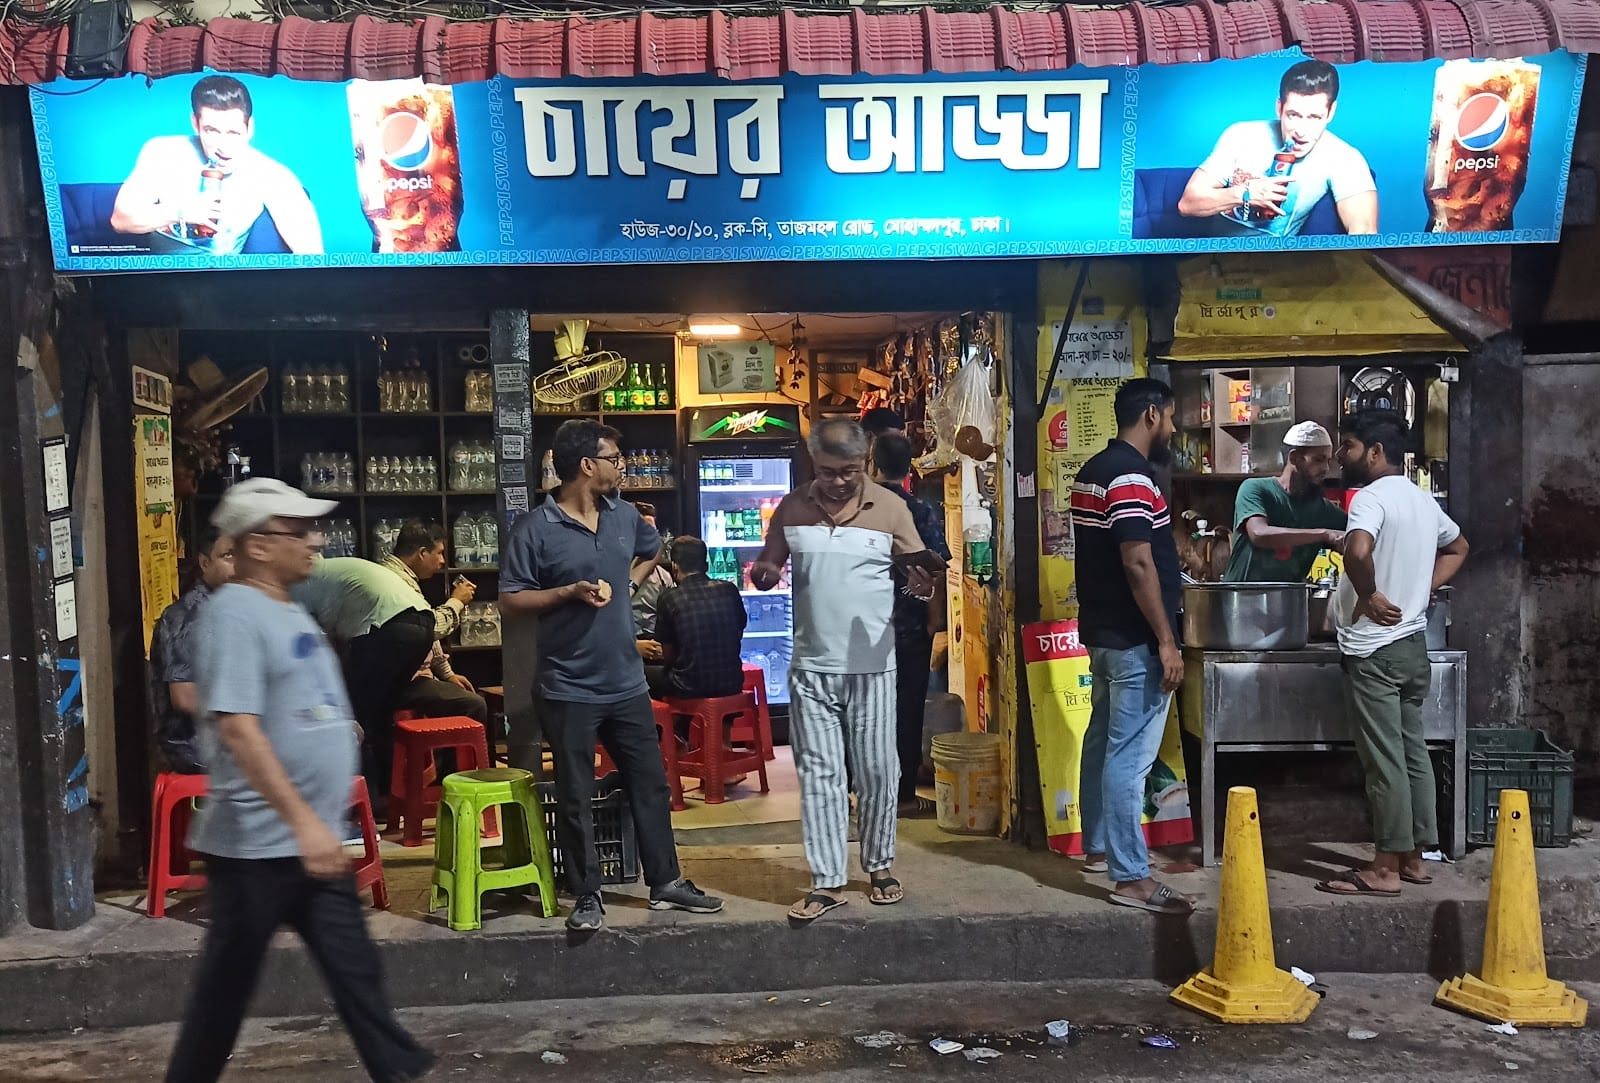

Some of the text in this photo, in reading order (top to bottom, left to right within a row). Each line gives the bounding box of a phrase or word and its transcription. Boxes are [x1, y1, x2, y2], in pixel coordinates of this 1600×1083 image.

[514, 79, 1110, 201] চায়ের আড্ডা
[1454, 155, 1500, 173] pepsi
[387, 175, 433, 193] pepsi
[619, 218, 719, 241] হাউজ-৩০/১০,
[722, 216, 773, 241] ব্লক-সি,
[777, 219, 838, 238] তাজমহল
[1036, 632, 1086, 653] চায়ে
